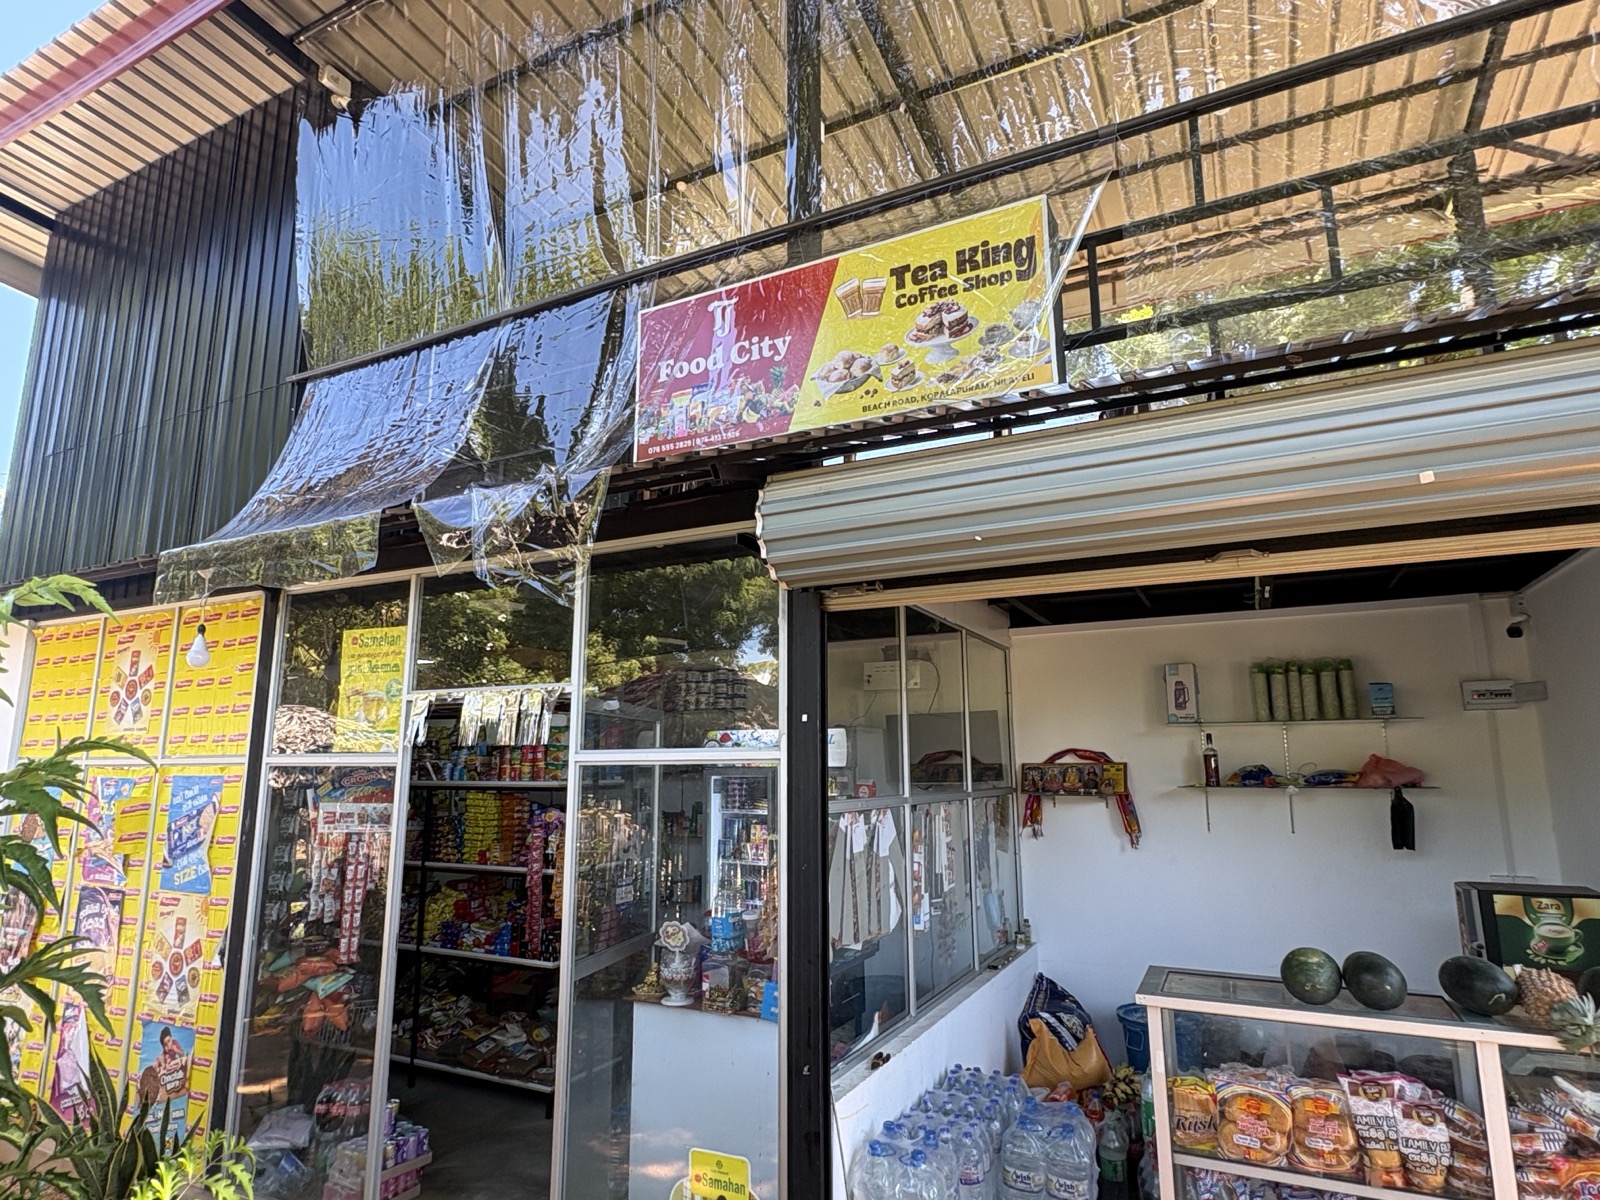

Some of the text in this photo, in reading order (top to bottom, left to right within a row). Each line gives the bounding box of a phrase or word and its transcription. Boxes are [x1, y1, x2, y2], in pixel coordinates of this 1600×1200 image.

[890, 235, 1037, 291] Tea King
[895, 269, 1013, 309] Coffee Shop
[657, 335, 792, 383] Food City
[862, 401, 891, 413] BEACH
[892, 396, 919, 406] ROAD,
[358, 631, 402, 648] Samahan
[1535, 900, 1562, 910] Zara
[1402, 1137, 1437, 1151] FAMILY
[702, 1172, 746, 1196] Samahan
